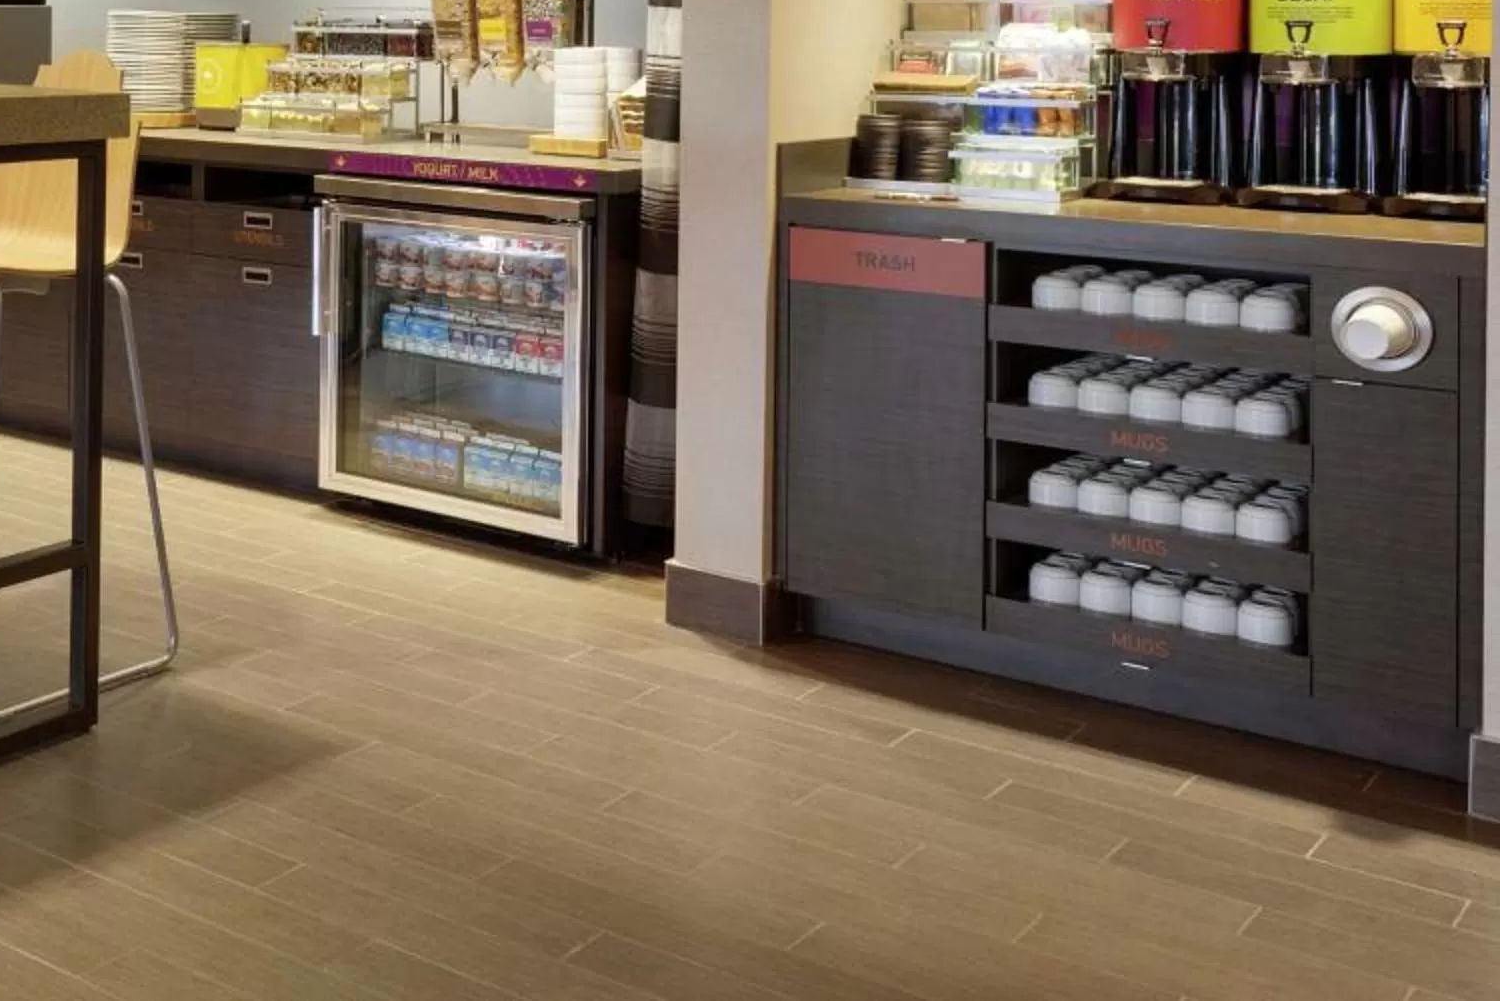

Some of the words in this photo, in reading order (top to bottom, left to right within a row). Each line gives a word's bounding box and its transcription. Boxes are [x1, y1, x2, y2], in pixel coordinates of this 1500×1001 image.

[413, 161, 457, 178] YOGURT
[467, 165, 499, 181] MILK
[852, 250, 916, 272] TRASH
[1111, 430, 1170, 453] MUGS
[1110, 532, 1167, 557] MUGS
[1110, 630, 1170, 658] MUGS
